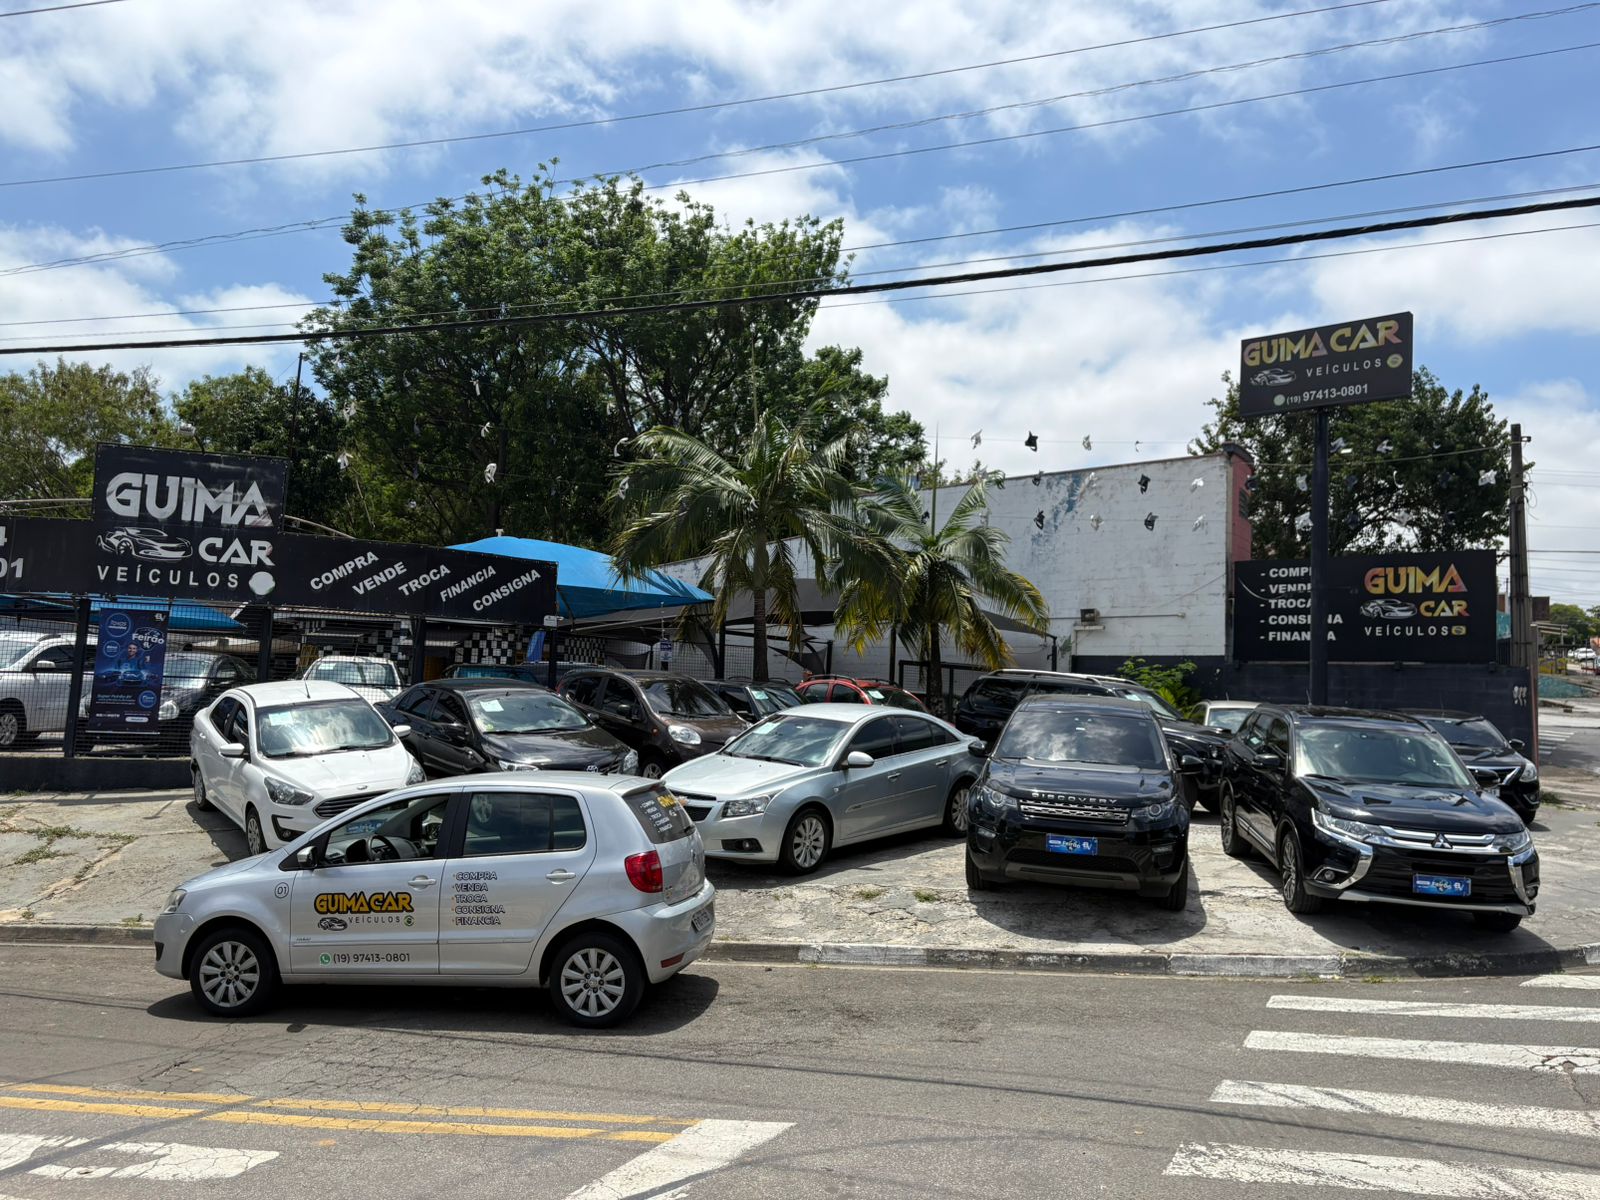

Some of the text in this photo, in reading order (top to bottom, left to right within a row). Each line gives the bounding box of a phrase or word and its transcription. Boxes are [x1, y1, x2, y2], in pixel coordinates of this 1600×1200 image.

[1243, 319, 1403, 366] GUIMA CAR
[1306, 358, 1382, 377] VEÍCULOS
[1303, 383, 1369, 402] 97413-0801
[106, 472, 273, 527] GUIMA
[198, 537, 275, 566] CAR
[97, 564, 239, 588] VEÍCULOS
[310, 551, 380, 590] COMPRA
[1269, 567, 1312, 578] COMP
[352, 561, 407, 596] VENDE
[398, 564, 451, 596] TROCA
[439, 565, 497, 602] FINANCIA
[1364, 563, 1468, 594] GUIMA
[472, 569, 542, 612] CONSIGNA
[1420, 600, 1470, 617] CAR
[1268, 614, 1343, 625] CONSIA
[1268, 631, 1336, 641] FINANA
[1364, 624, 1449, 637] VEÍCULOS
[132, 632, 165, 645] Feirão
[1032, 792, 1117, 804] DISCOVERY
[456, 871, 498, 881] COMPRA
[277, 886, 287, 895] 01
[455, 883, 489, 892] VENDA
[455, 894, 488, 903] TROCA
[455, 905, 506, 914] CONSIGNA
[348, 915, 401, 924] VEÍCULOS
[455, 916, 501, 926] FINANCIA
[333, 953, 410, 964] (19) 97413-0801
